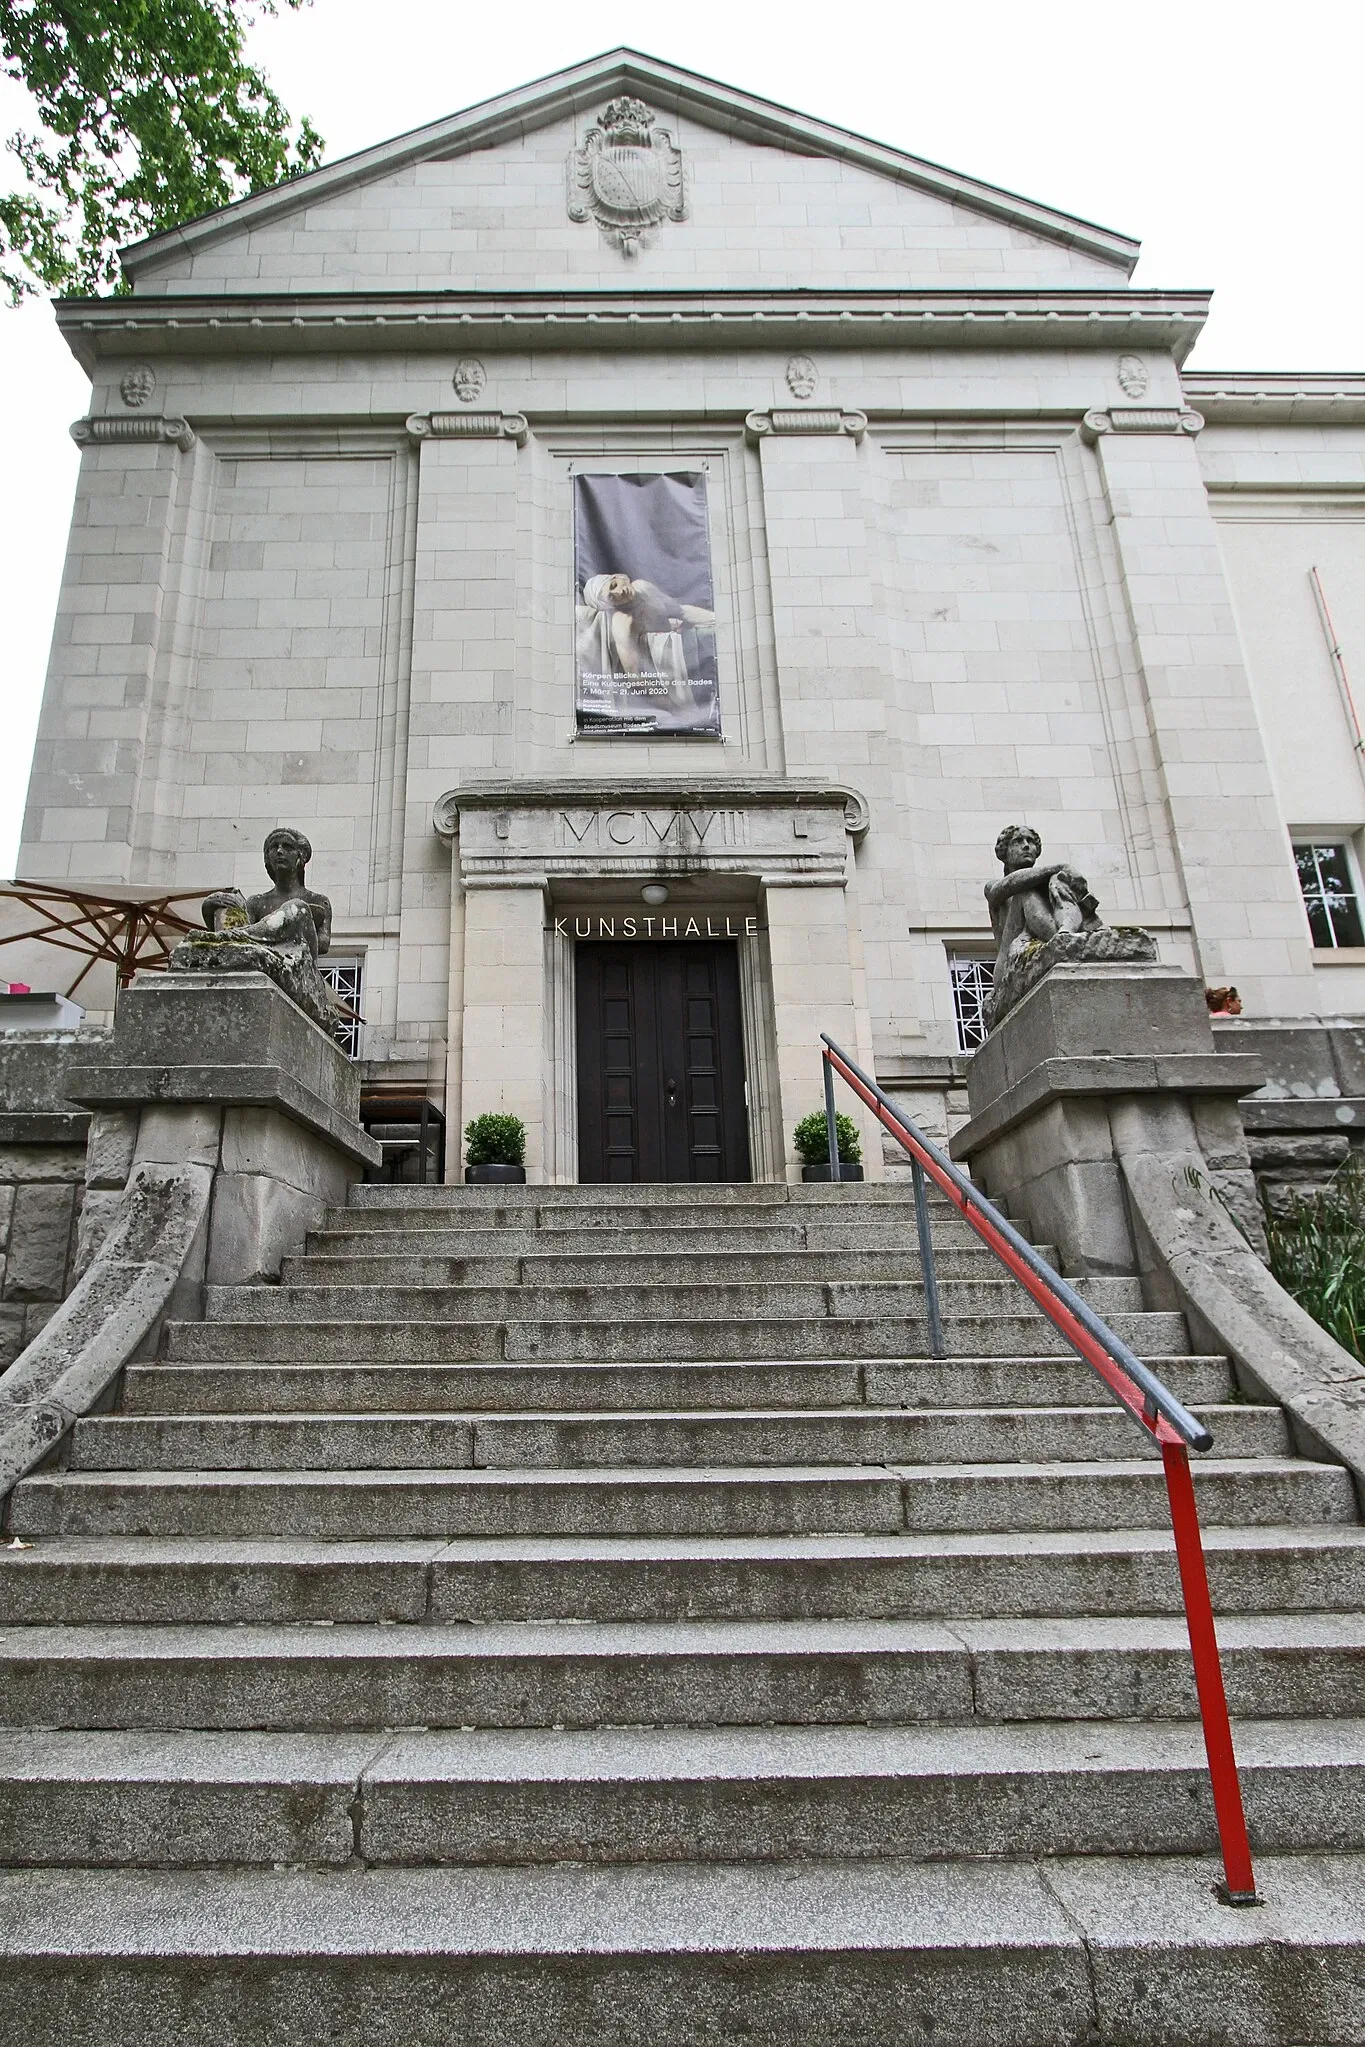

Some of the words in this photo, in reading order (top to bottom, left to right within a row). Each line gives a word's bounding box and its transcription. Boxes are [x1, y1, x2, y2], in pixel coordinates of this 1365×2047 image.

[583, 679, 600, 687] Eine
[601, 679, 670, 689] Kulturgeschichte
[688, 678, 713, 686] Bades
[583, 687, 588, 695] 7.
[590, 687, 611, 695] März
[648, 687, 669, 695] 2020
[554, 917, 758, 938] KUNSTHALLE
